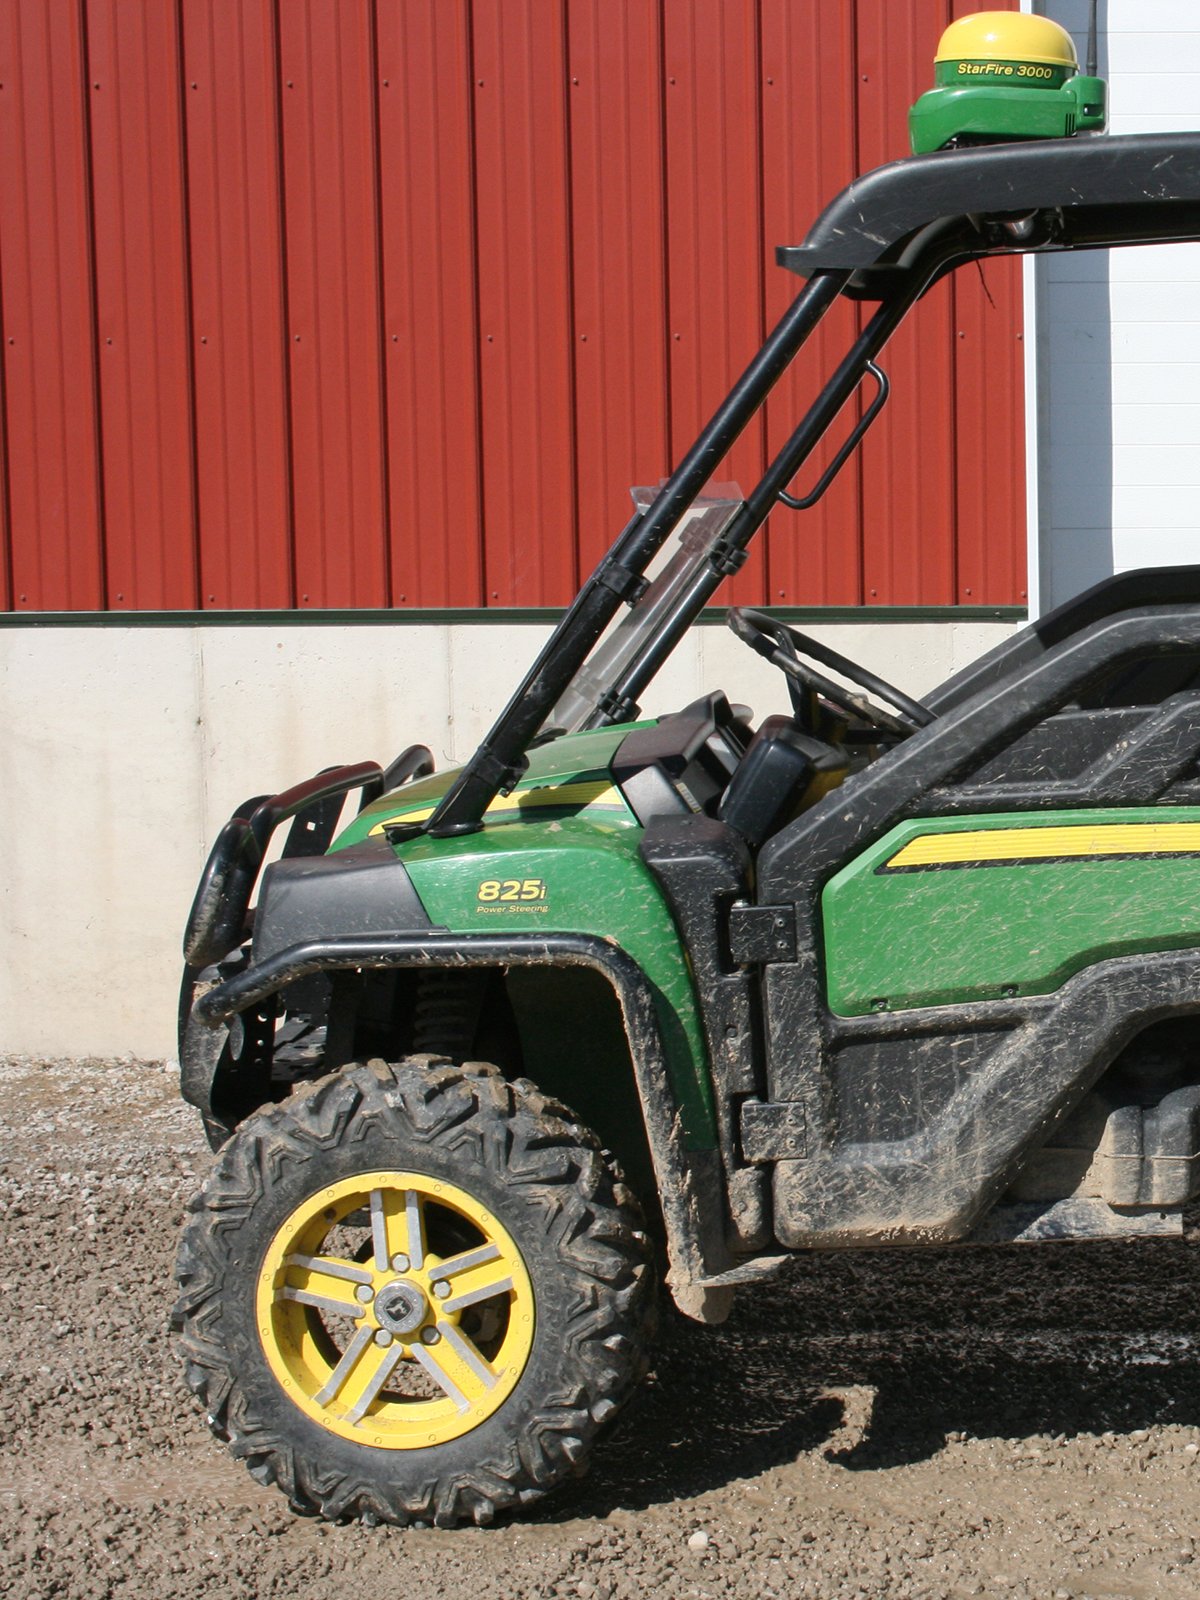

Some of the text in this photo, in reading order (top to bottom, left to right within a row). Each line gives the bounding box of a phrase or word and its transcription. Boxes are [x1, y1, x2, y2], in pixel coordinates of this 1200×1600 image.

[957, 63, 1052, 79] StarFire 3000
[477, 879, 547, 901] 825i
[476, 904, 549, 914] Power Steering
